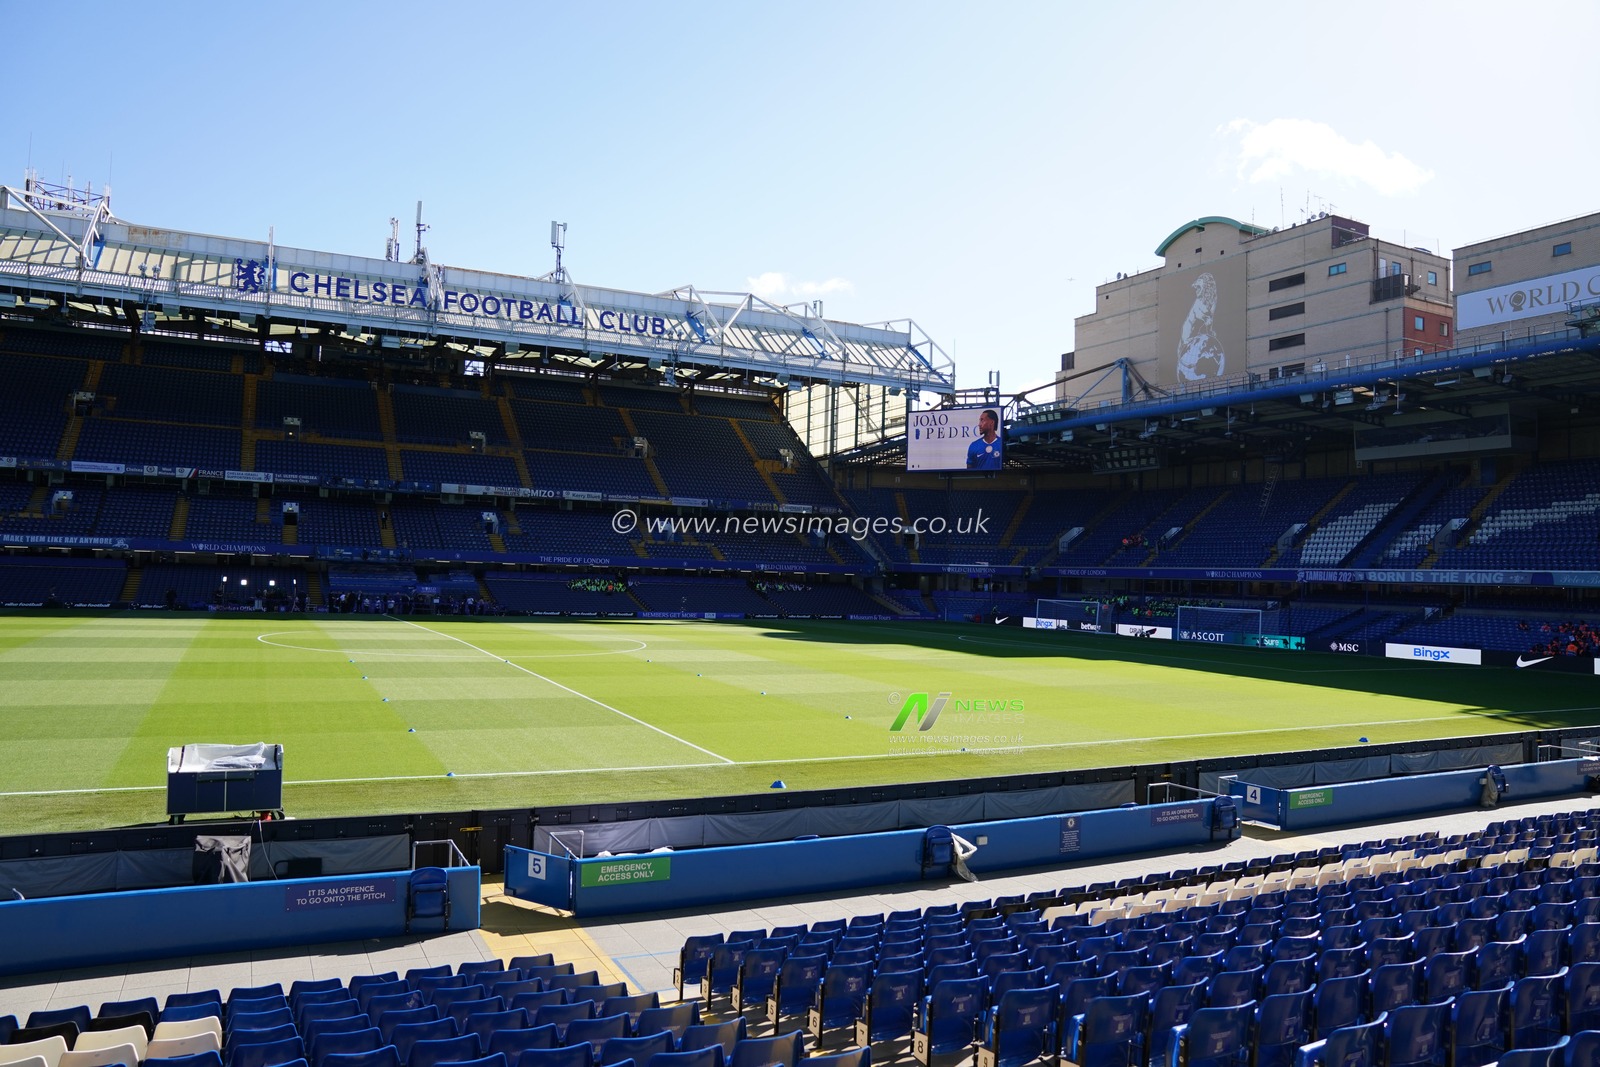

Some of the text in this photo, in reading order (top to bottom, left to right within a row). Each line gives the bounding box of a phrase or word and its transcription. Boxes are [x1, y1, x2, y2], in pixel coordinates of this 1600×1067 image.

[290, 271, 666, 336] CHELSEA FOOTBALL CLUB
[913, 413, 948, 427] JOÃO
[530, 489, 554, 497] MIZO
[1305, 571, 1337, 582] TAMBLING
[1368, 572, 1504, 583] BORN IS THE KING
[1191, 632, 1224, 642] ASCOTT
[1264, 636, 1280, 646] Sure
[1339, 643, 1359, 652] MSC
[1250, 789, 1257, 800] 4
[1299, 792, 1324, 800] EMERGENCY
[533, 858, 541, 874] 5
[601, 862, 652, 873] EMERGENCY
[597, 870, 655, 882] ACCESS ONLY
[340, 885, 374, 894] OFFENCE
[676, 974, 680, 984] 2
[733, 994, 738, 1003] 4
[769, 1005, 774, 1015] 5
[812, 1017, 818, 1028] 6
[918, 1041, 923, 1053] 8
